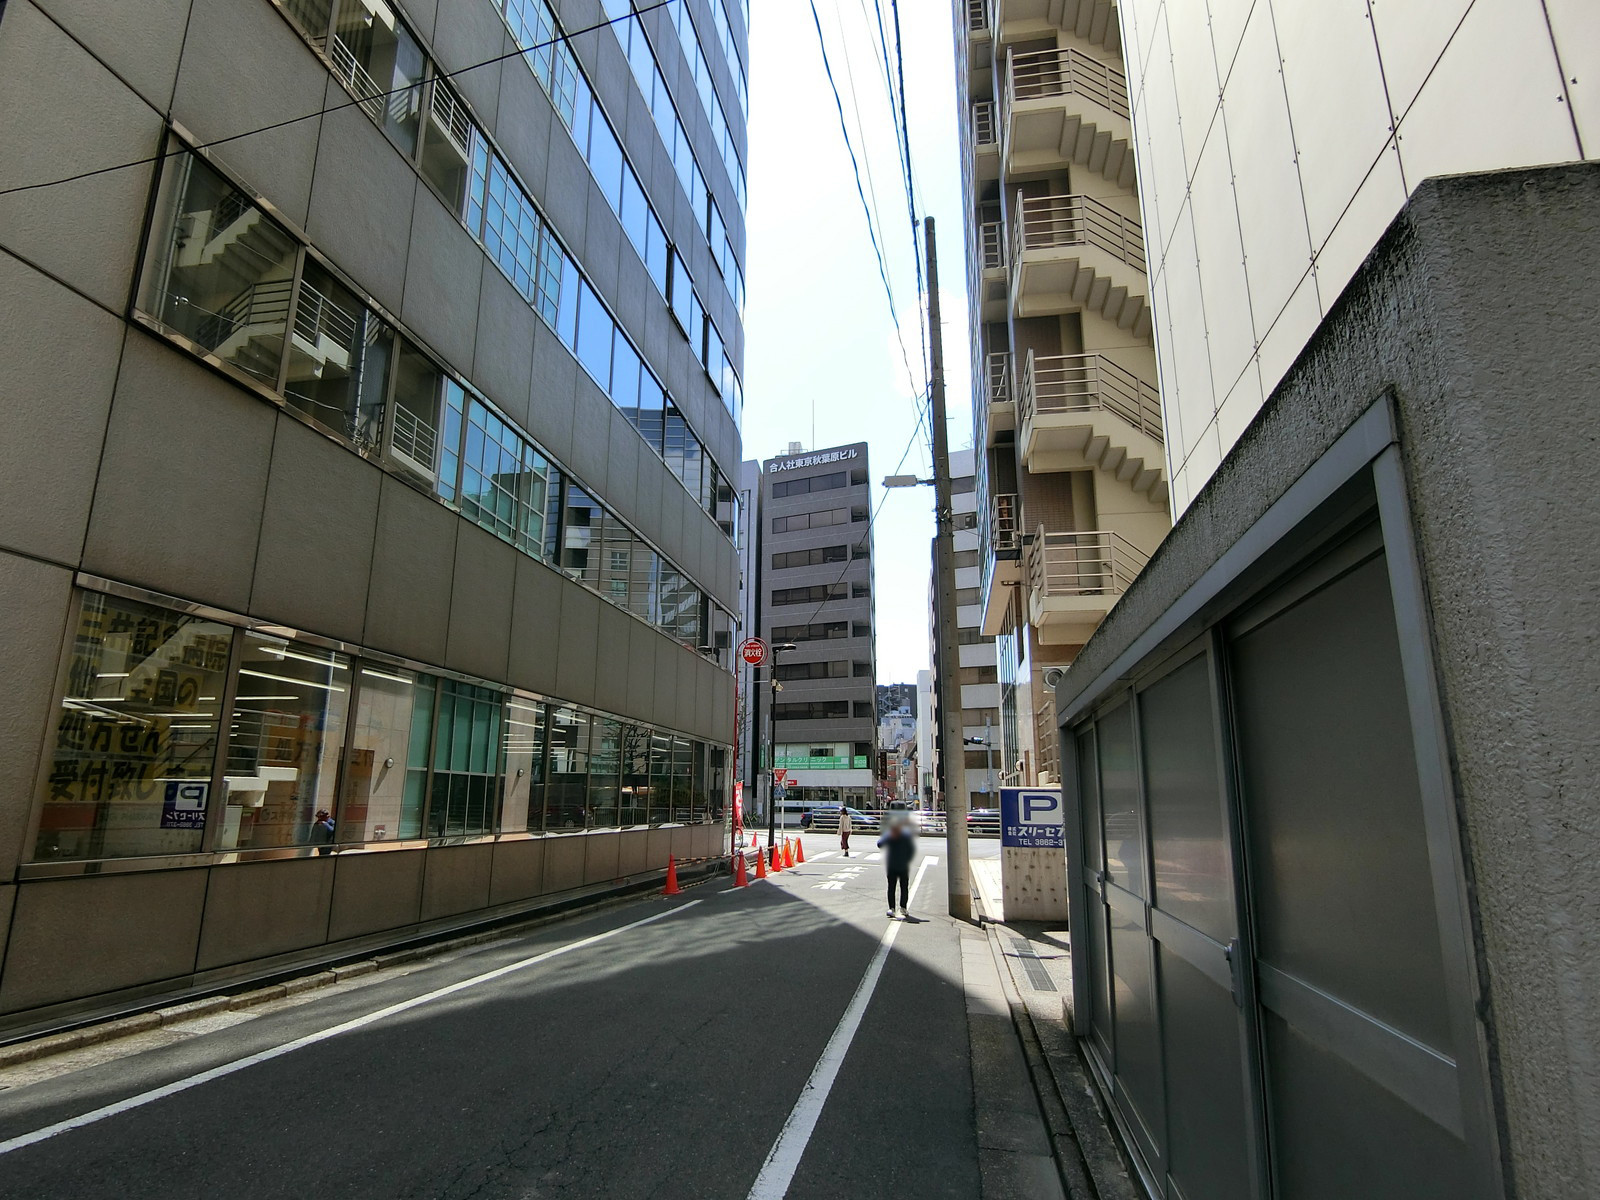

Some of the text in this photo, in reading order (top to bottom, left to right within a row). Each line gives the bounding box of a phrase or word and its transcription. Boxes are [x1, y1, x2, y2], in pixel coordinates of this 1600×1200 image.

[769, 448, 858, 473] 合人社東京秋葉原ビル
[744, 648, 762, 658] 消火栓
[1023, 795, 1058, 821] P
[1018, 838, 1032, 846] TEL
